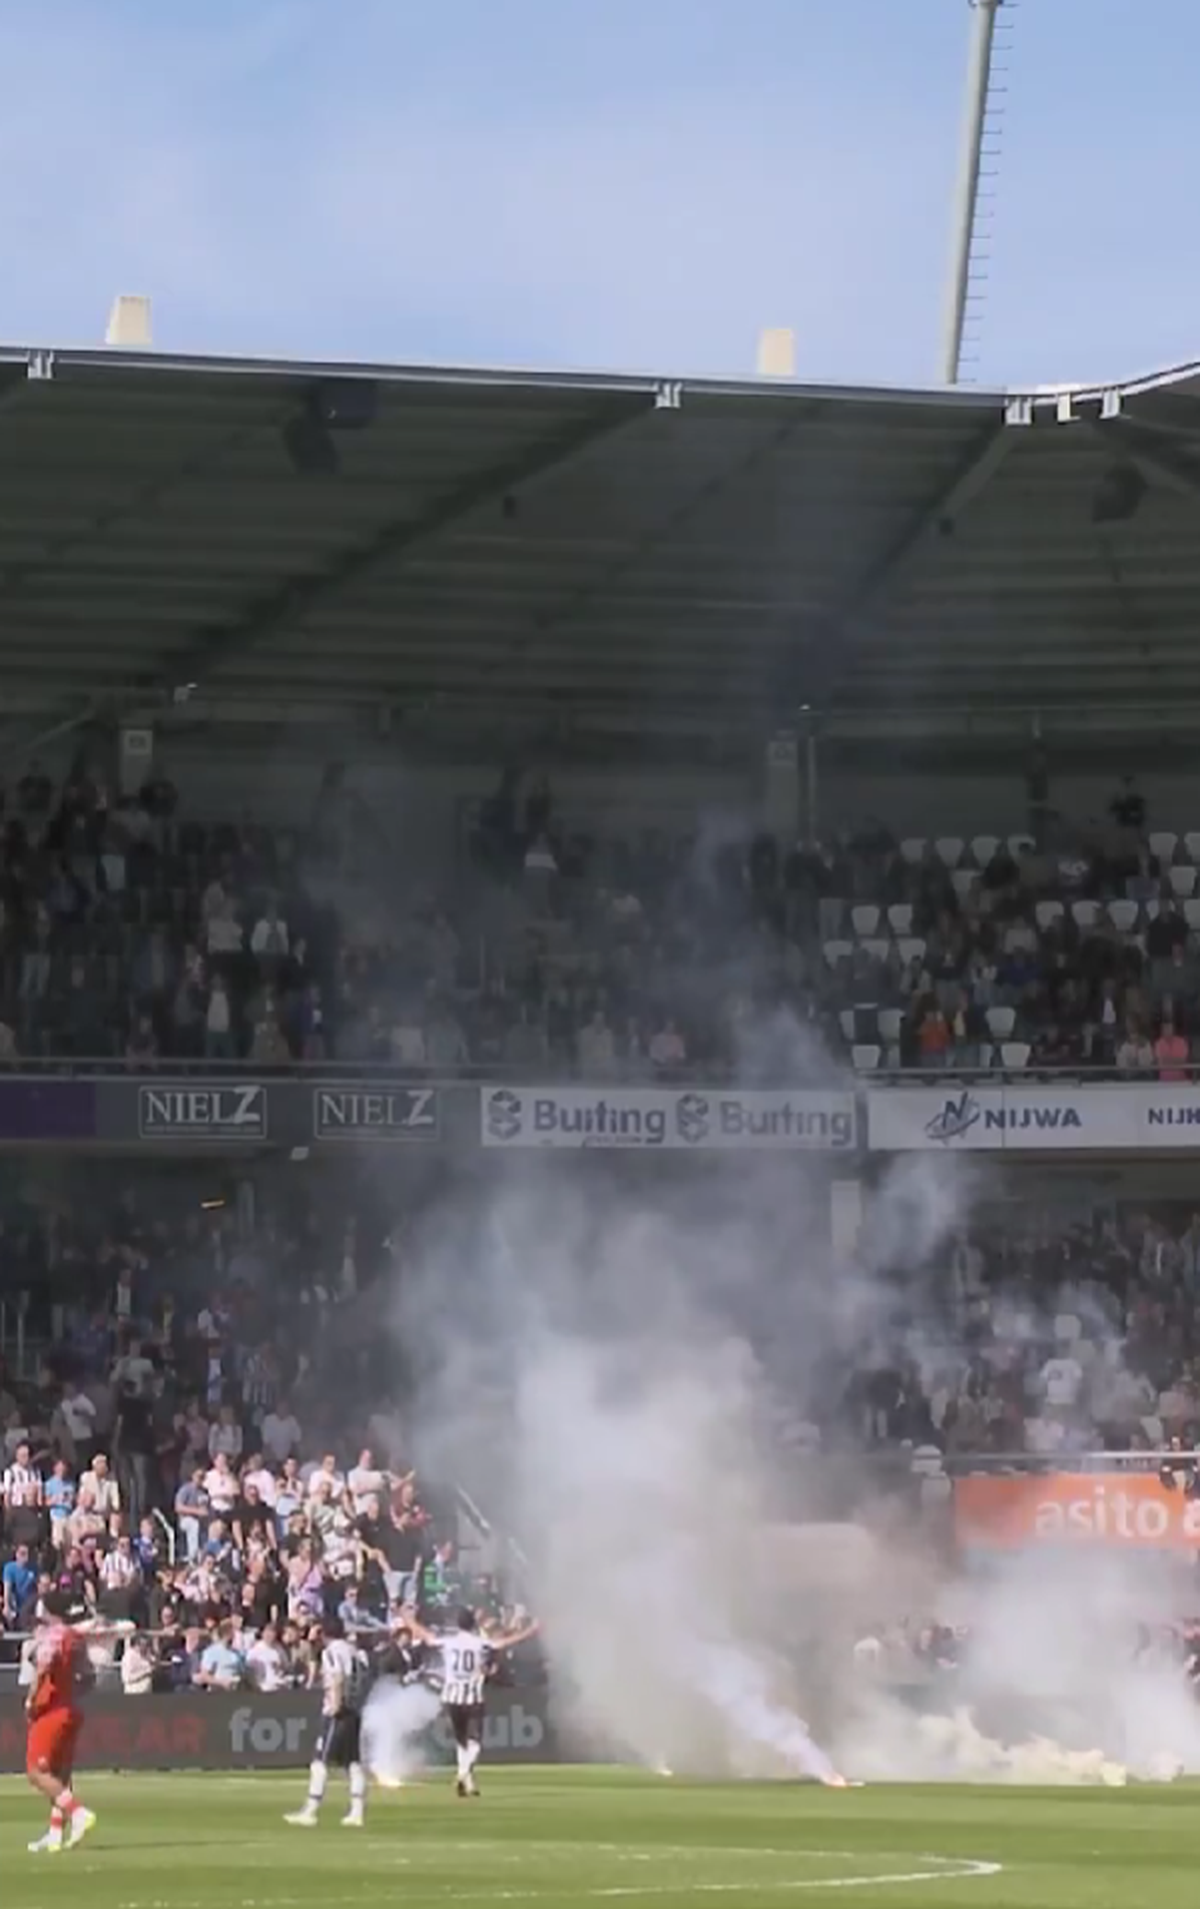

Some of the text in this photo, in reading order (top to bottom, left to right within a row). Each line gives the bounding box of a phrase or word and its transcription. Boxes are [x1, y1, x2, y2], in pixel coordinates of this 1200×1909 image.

[145, 1085, 261, 1123] NIELZ
[322, 1089, 435, 1126] NIELZ
[985, 1108, 1082, 1129] NIJWA
[1035, 1485, 1169, 1538] asito
[229, 1706, 307, 1752] for
